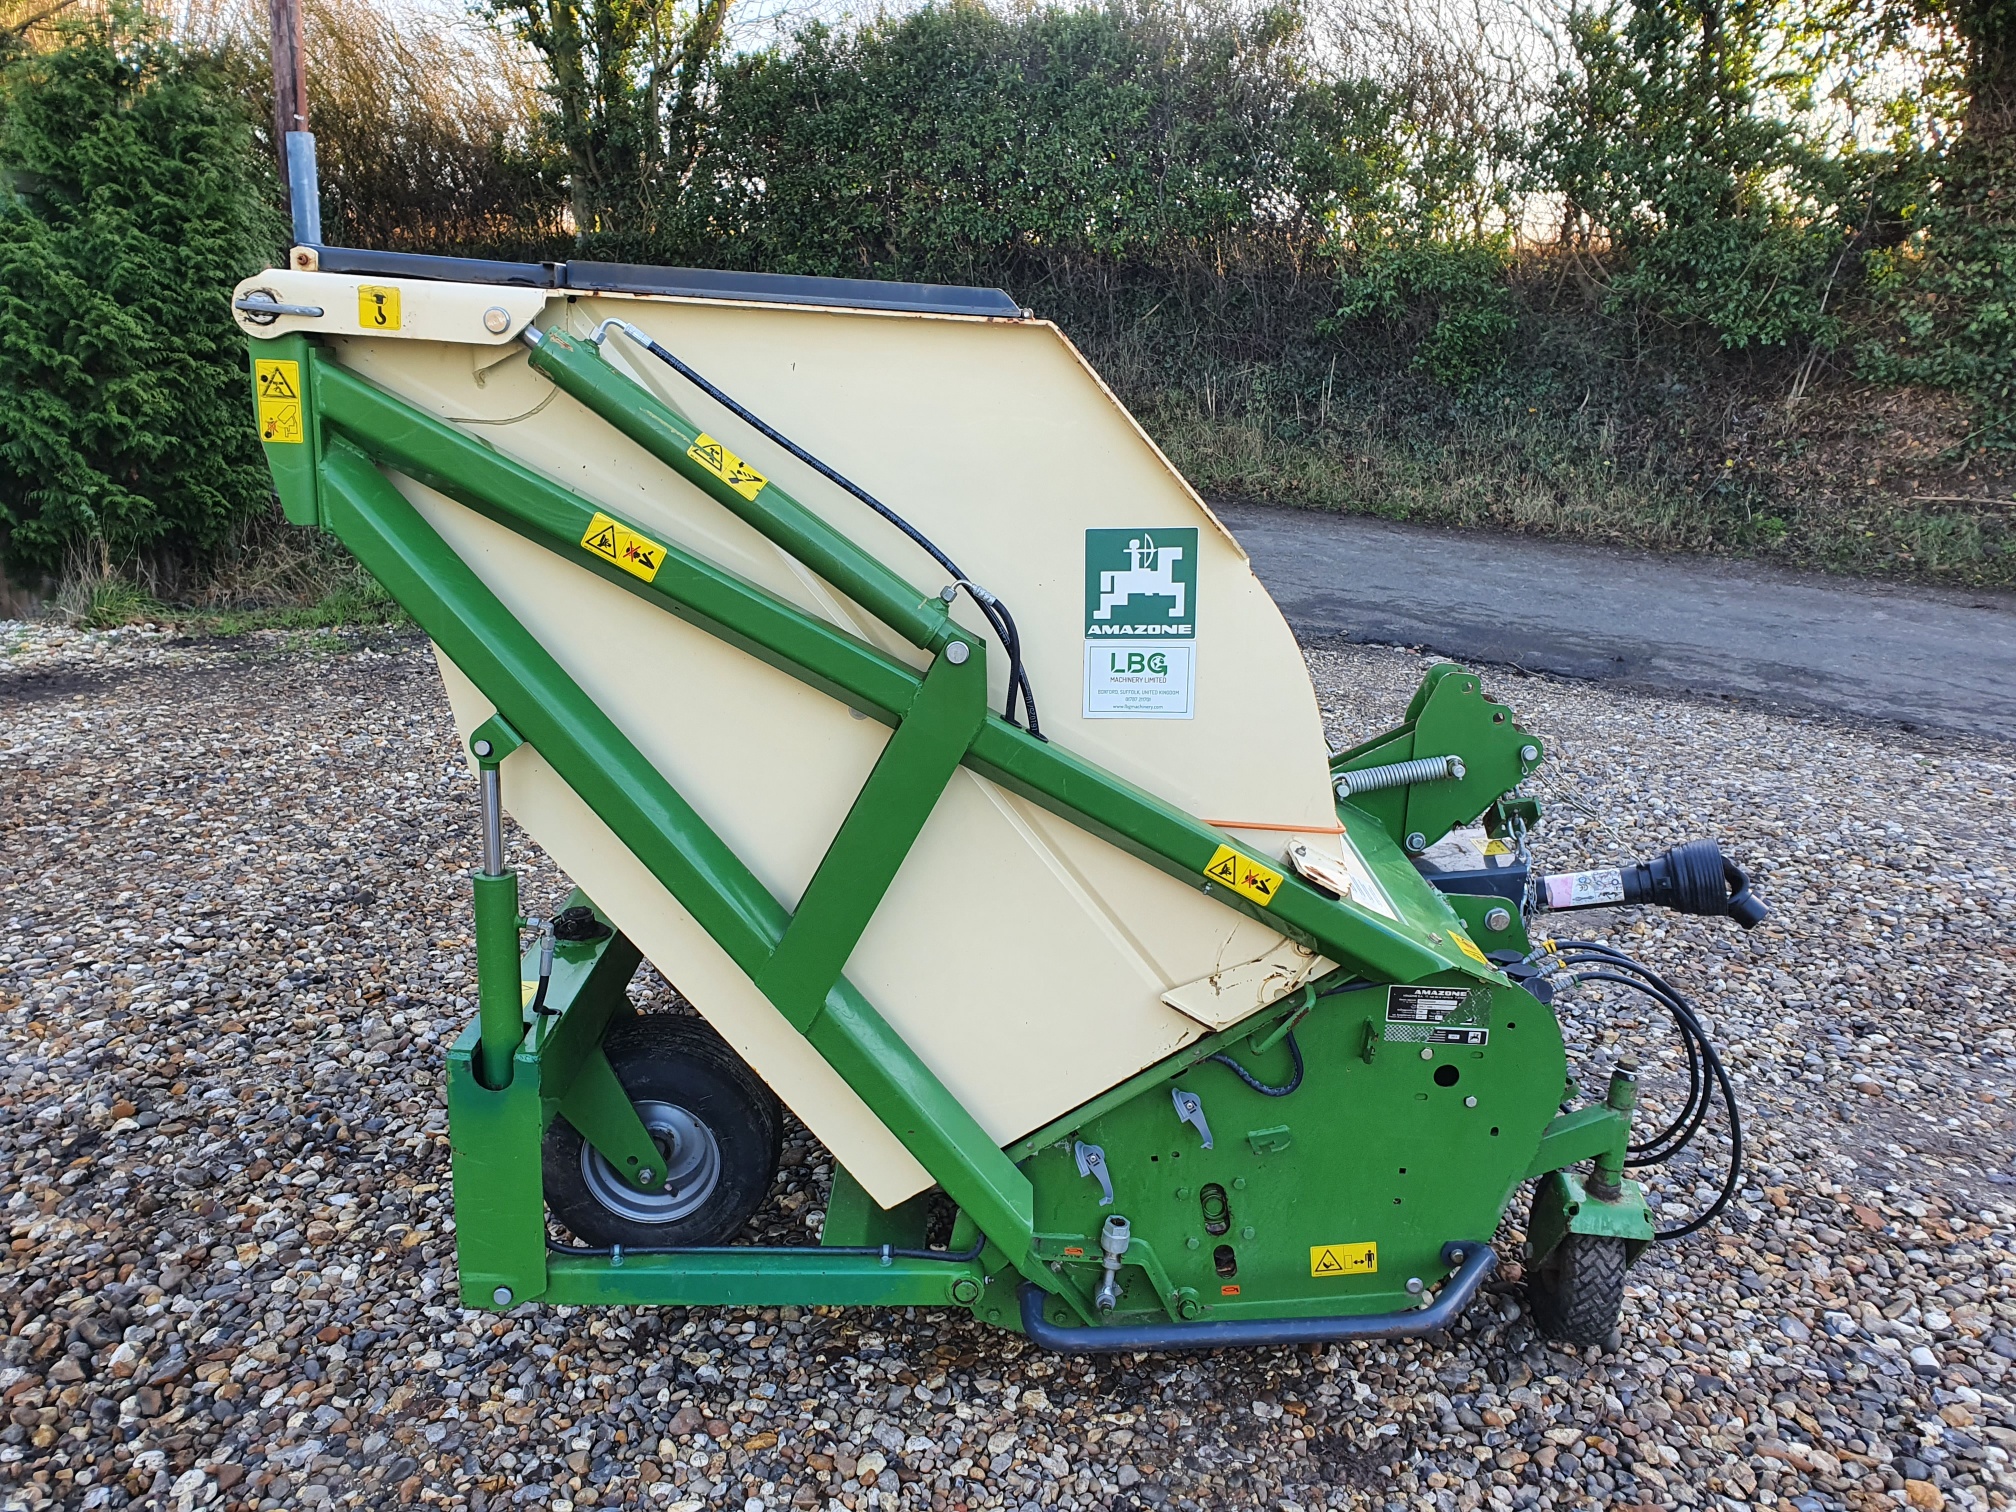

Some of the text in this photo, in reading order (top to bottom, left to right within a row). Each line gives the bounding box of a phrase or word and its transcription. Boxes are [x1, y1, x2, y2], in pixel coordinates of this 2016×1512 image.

[740, 410, 756, 424] 192
[831, 472, 847, 486] SAE
[884, 509, 922, 542] HYDROPLAST
[1087, 624, 1192, 635] AMAZONE
[1111, 652, 1168, 677] LBG
[1110, 676, 1167, 684] MACHINERY LIMITED
[1414, 989, 1467, 997] AMAZONE
